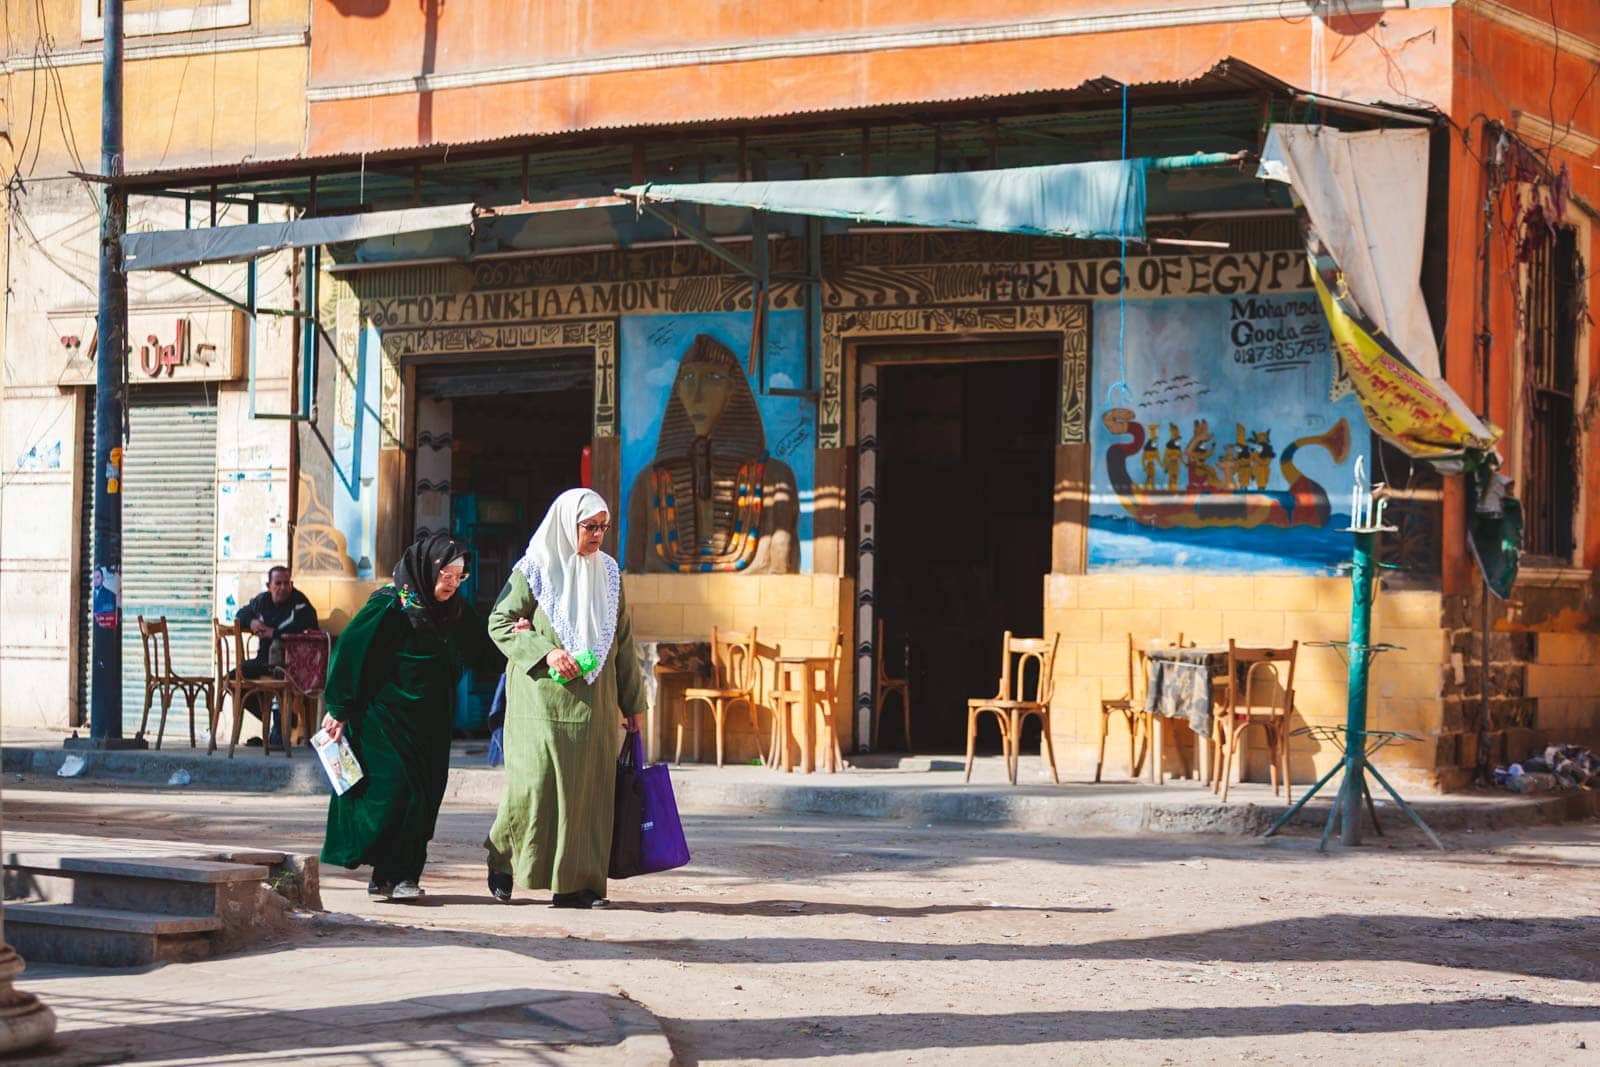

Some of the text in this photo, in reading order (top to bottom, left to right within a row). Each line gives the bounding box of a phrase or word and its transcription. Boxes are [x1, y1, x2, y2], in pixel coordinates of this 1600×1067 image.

[1138, 258, 1182, 296] OF
[1186, 250, 1315, 294] EGYPT
[400, 280, 660, 323] TOTANKHAAMON
